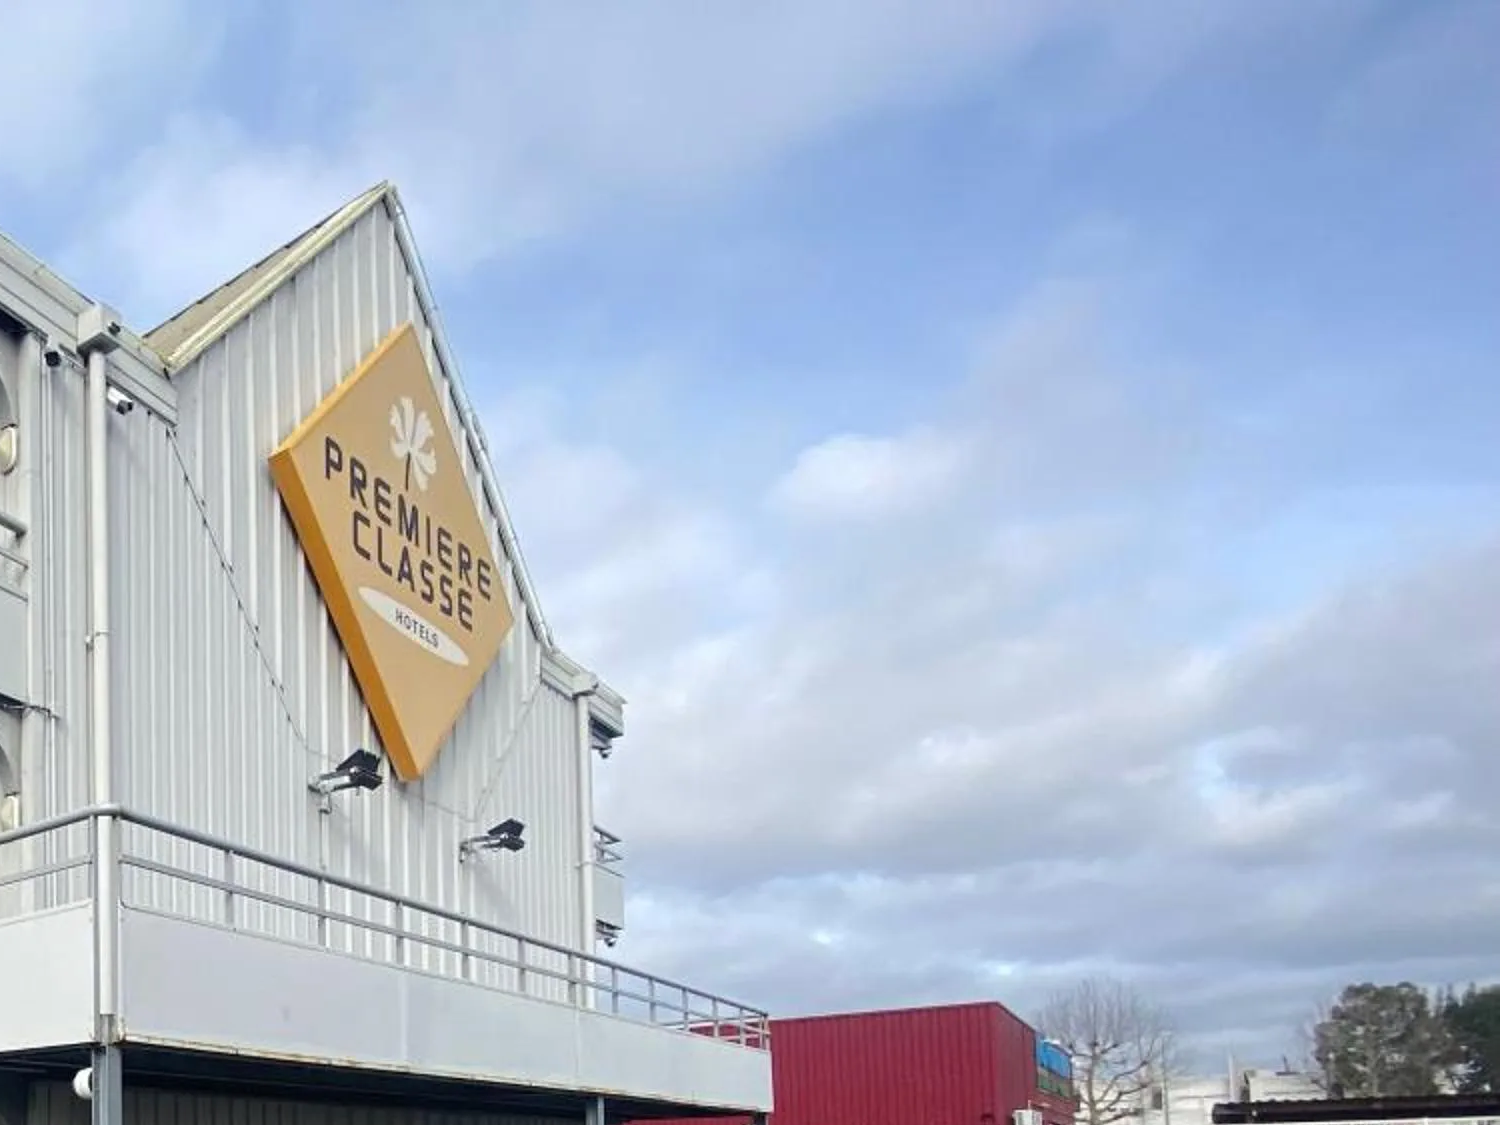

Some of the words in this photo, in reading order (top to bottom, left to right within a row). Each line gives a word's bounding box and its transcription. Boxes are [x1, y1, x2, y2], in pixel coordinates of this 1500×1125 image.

[325, 437, 491, 601] PREMIERE
[353, 511, 473, 632] CLASSE
[395, 608, 439, 649] HOTELS
